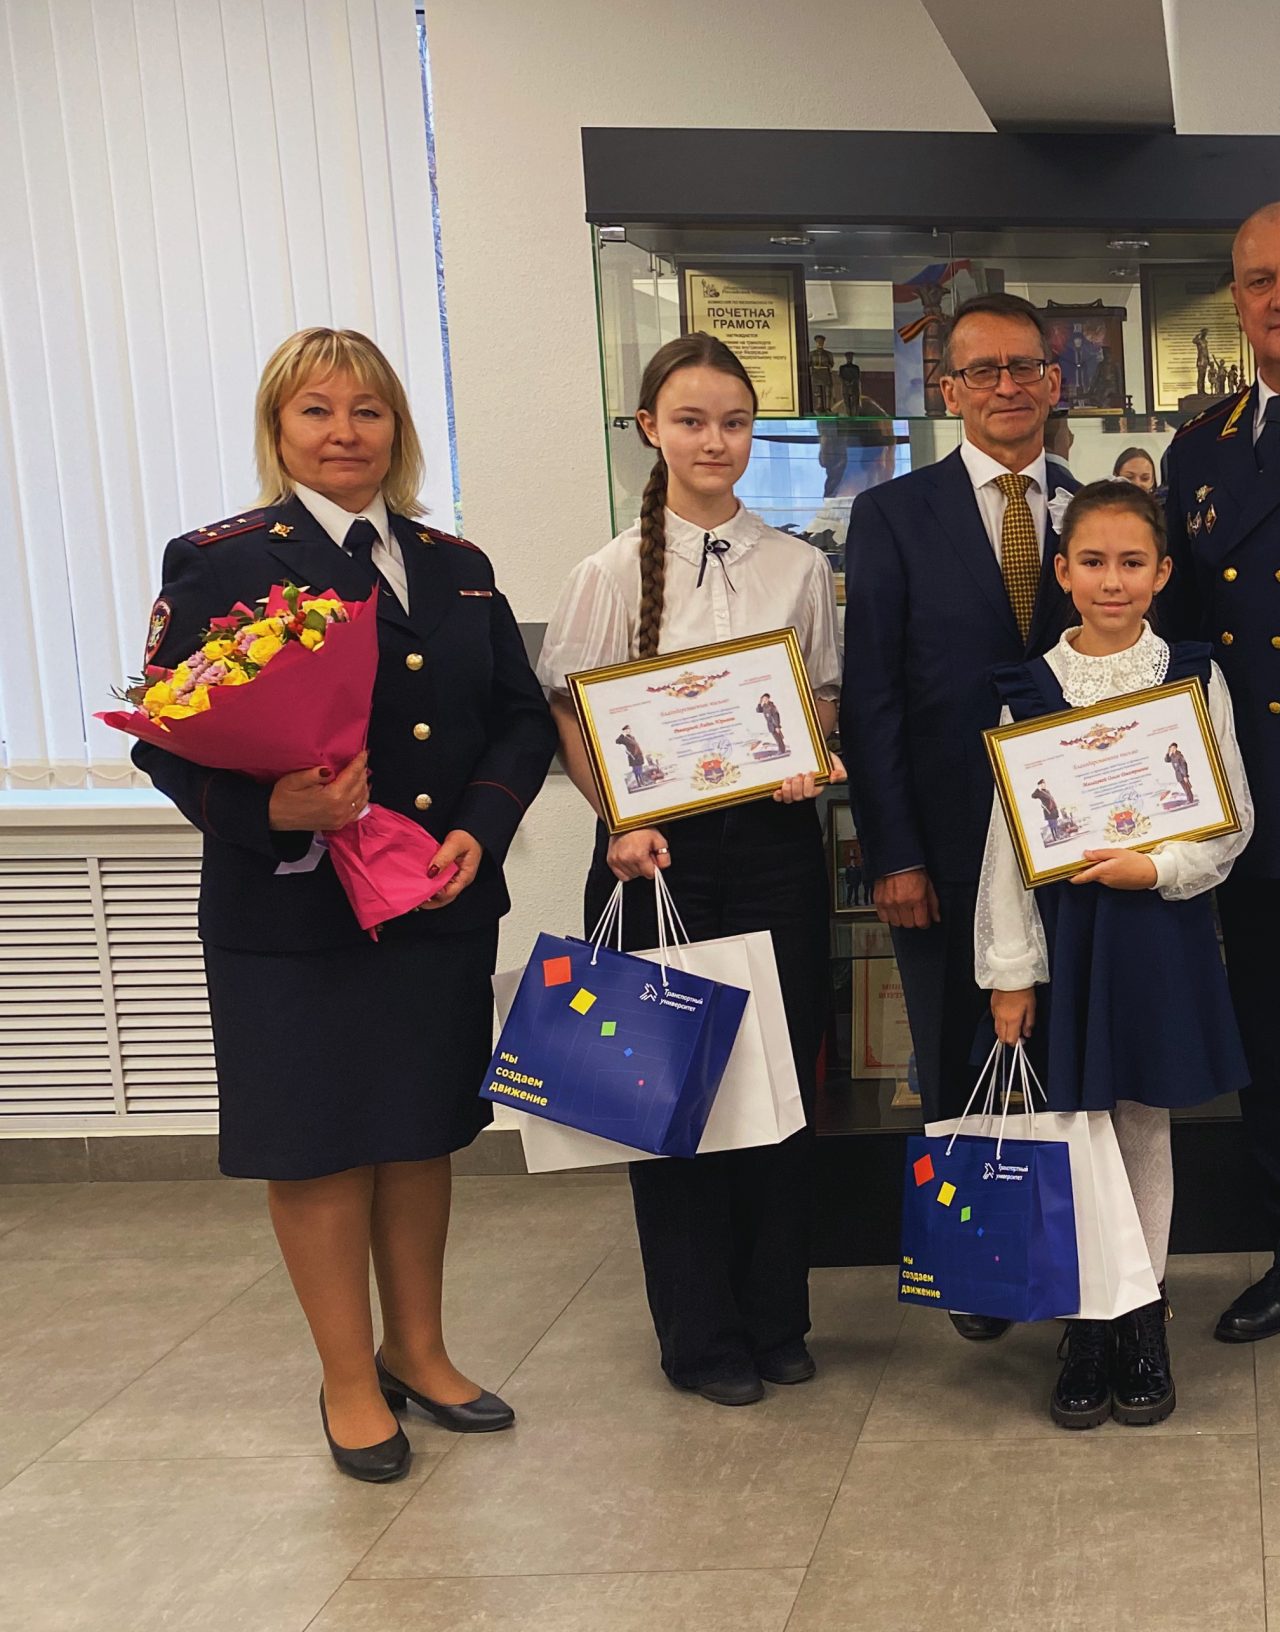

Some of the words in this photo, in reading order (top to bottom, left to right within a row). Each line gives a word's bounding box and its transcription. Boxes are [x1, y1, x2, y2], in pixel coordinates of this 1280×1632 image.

[707, 307, 775, 318] ПОЧЕТНАЯ
[713, 319, 770, 329] ГРАМОТА
[664, 988, 704, 1005] Транспортный
[659, 998, 696, 1012] университет
[500, 1051, 519, 1065] мы
[495, 1066, 544, 1089] создаем
[488, 1081, 548, 1107] движение
[903, 1255, 914, 1265] мы
[902, 1270, 934, 1283] создаем
[901, 1284, 941, 1299] движение
